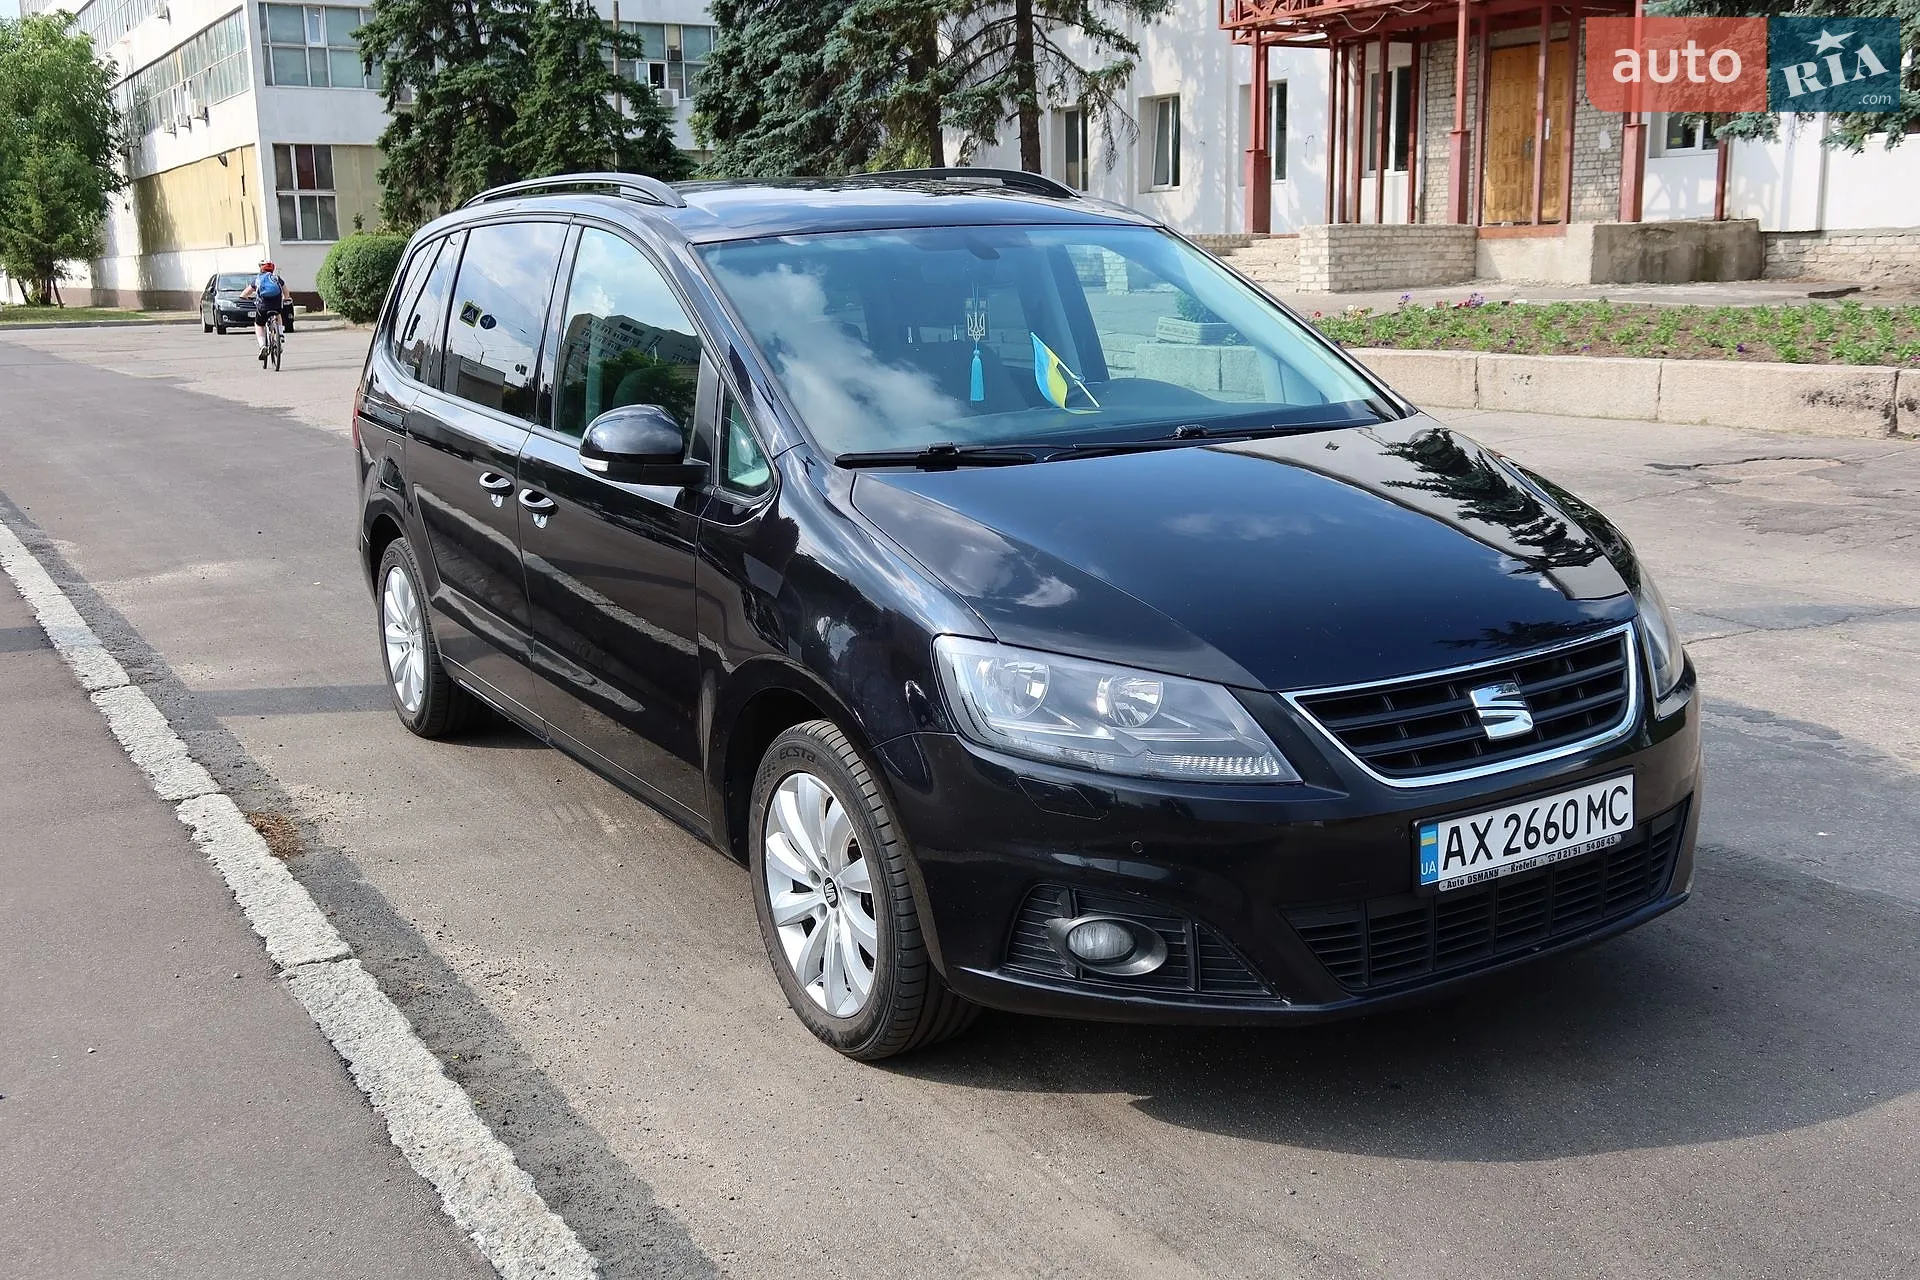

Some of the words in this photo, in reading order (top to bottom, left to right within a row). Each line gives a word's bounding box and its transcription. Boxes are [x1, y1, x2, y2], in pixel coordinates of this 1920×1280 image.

[1442, 815, 1494, 870] AX
[1502, 798, 1579, 857] 2660
[1586, 785, 1629, 835] MC
[1421, 861, 1437, 876] UA
